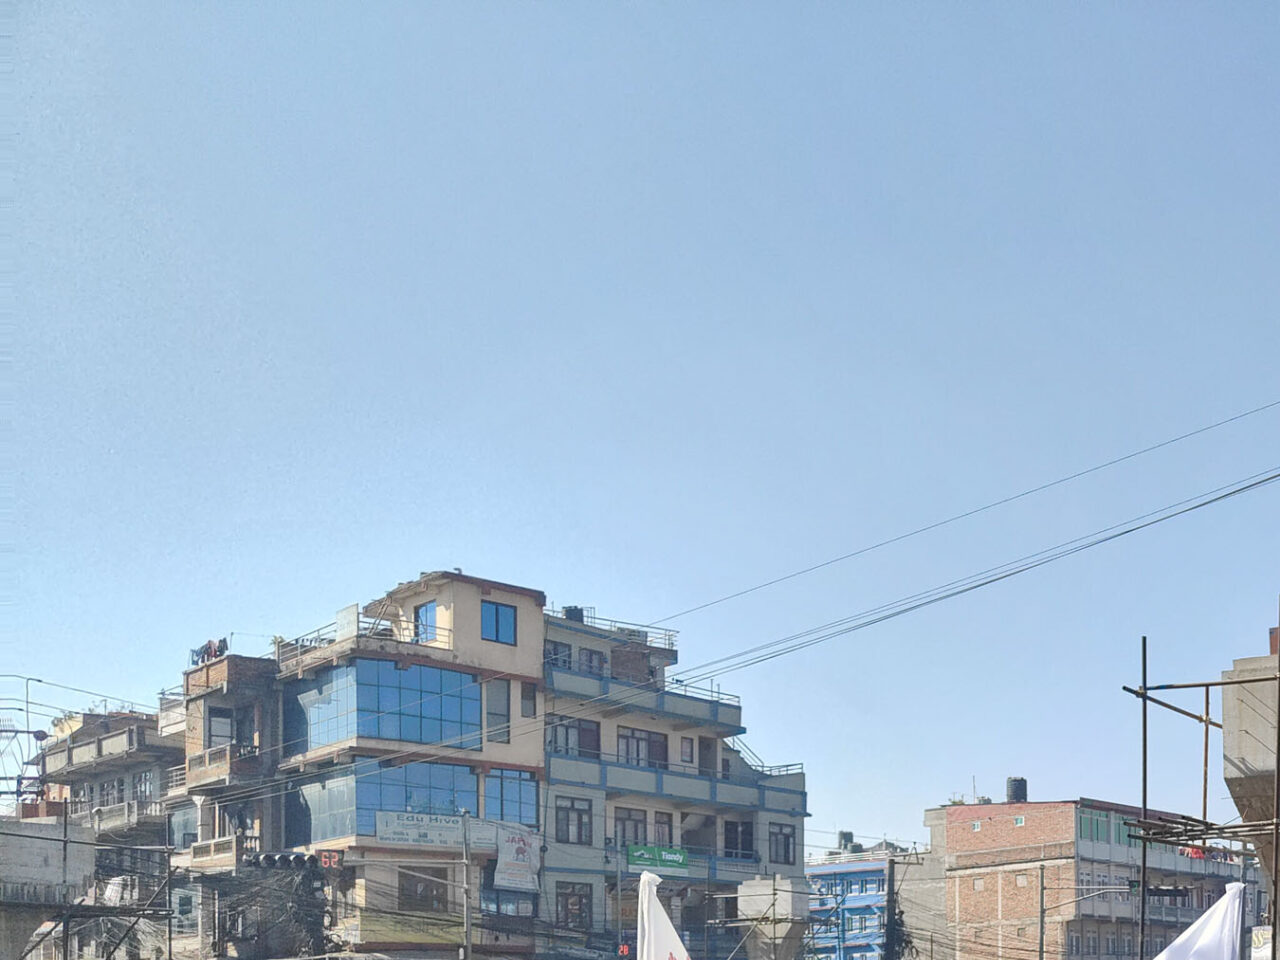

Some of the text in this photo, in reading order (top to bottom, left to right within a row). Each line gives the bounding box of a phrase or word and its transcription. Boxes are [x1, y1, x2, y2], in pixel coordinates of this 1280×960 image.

[396, 814, 460, 825] Edu Hive
[321, 852, 340, 868] 62
[661, 851, 684, 864] Tiandy
